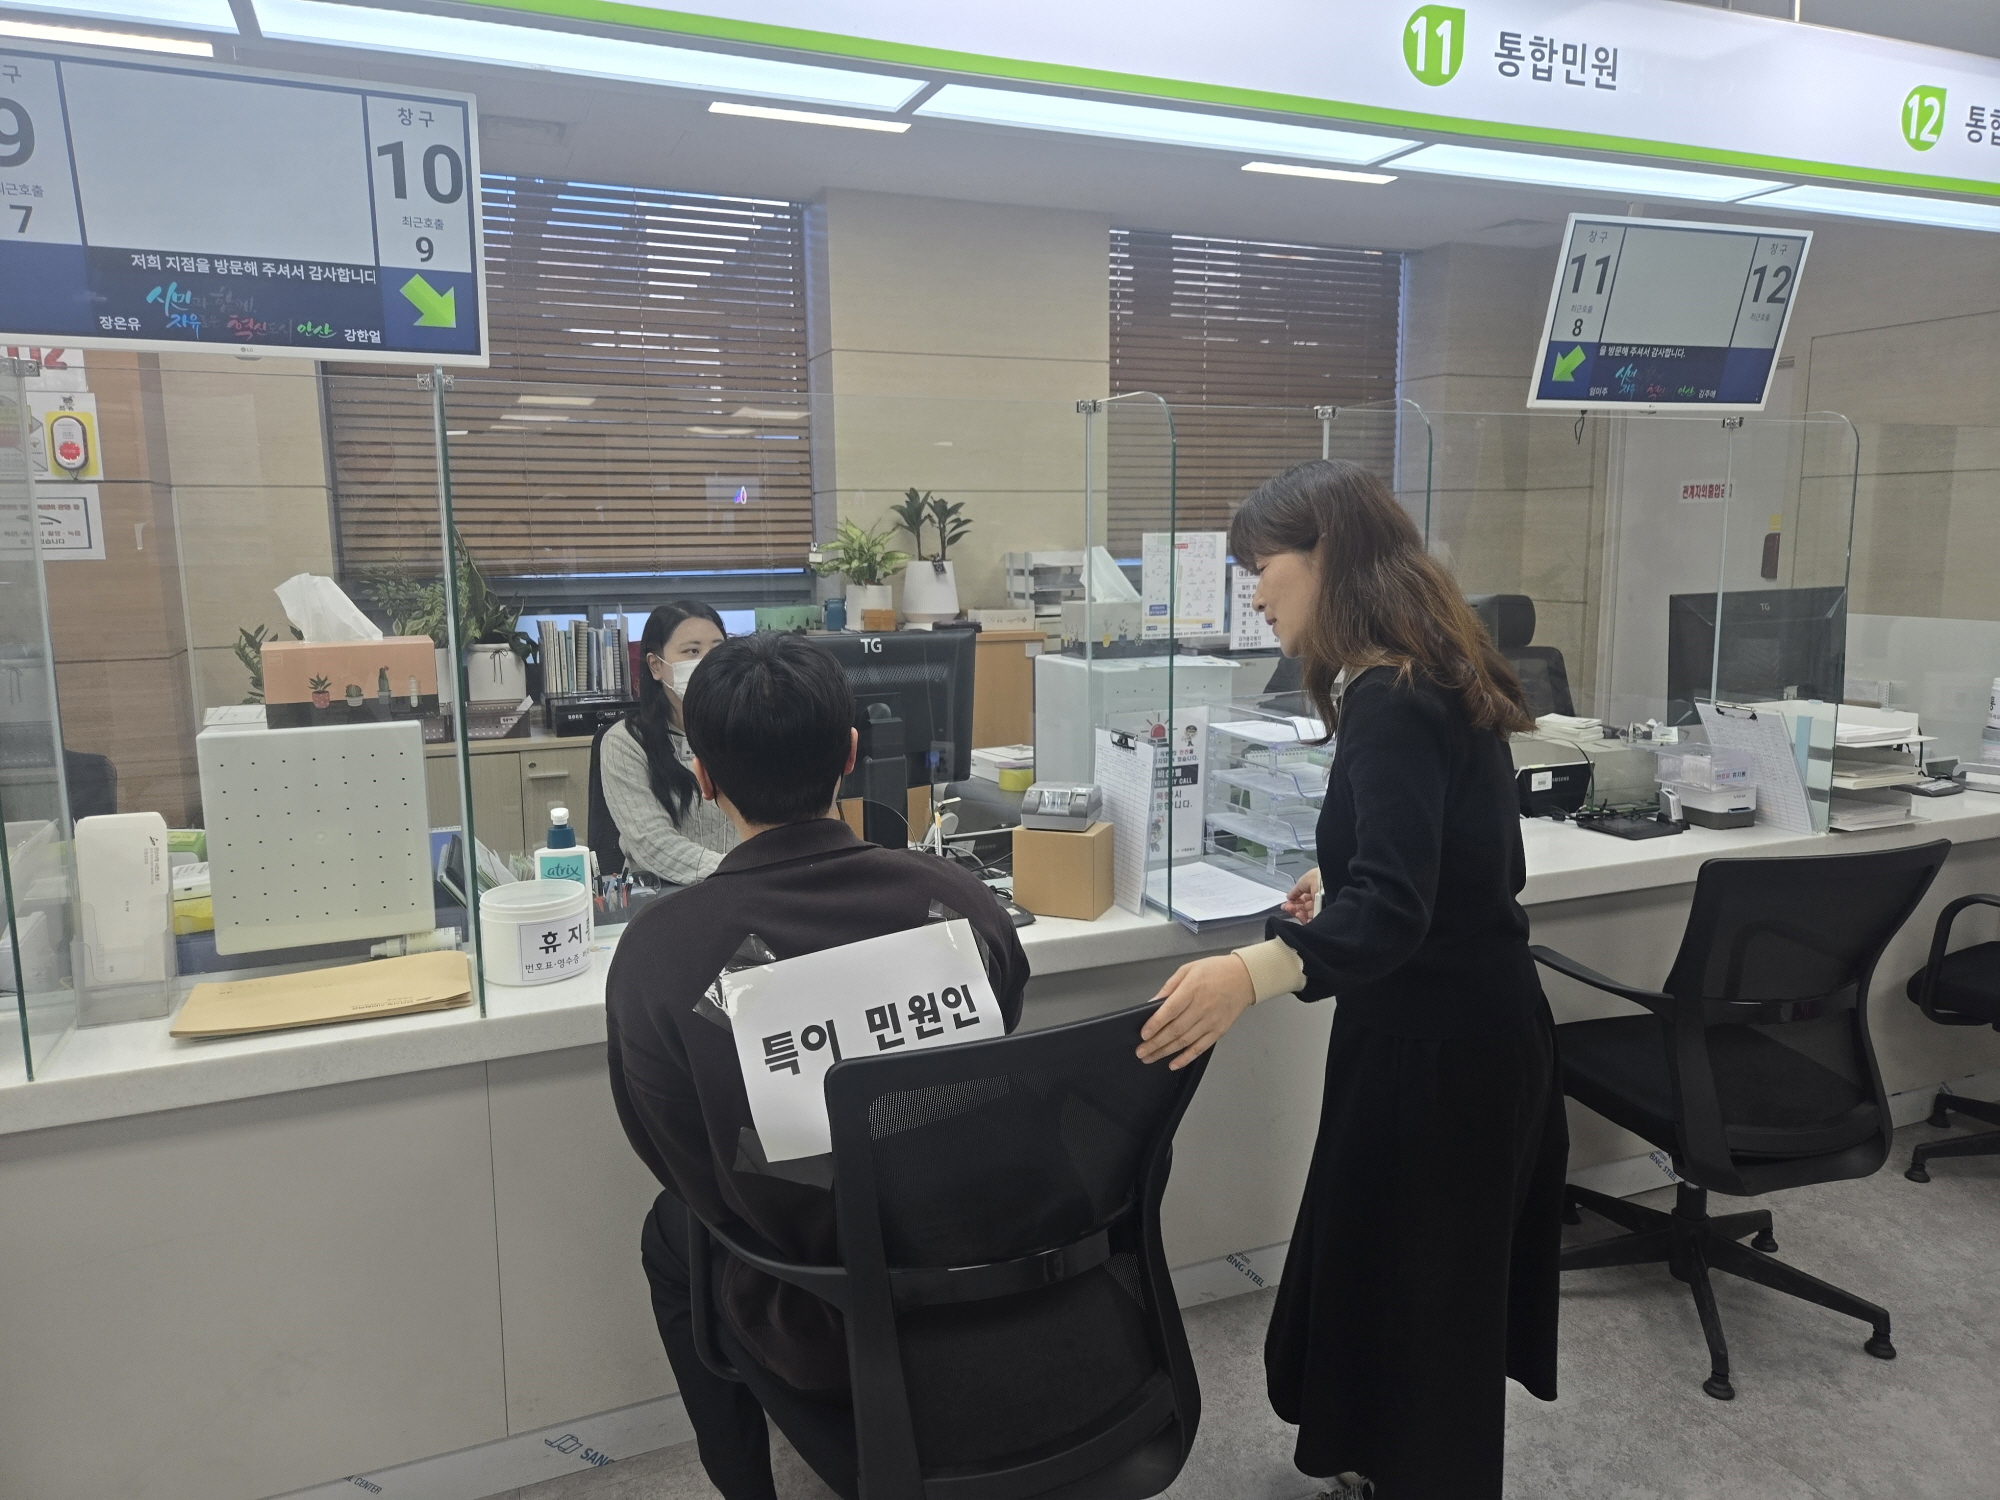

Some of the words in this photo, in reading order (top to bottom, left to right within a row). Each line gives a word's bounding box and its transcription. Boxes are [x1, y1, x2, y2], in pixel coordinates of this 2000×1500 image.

[1410, 16, 1453, 75] 11
[2, 64, 22, 83] 구
[1494, 31, 1620, 91] 통합민원
[1907, 94, 1942, 142] 12
[0, 97, 35, 167] 9
[377, 140, 463, 204] 10
[0, 182, 44, 198] 근호출
[9, 204, 33, 233] 7
[402, 216, 445, 231] 최근호출
[415, 236, 434, 262] 9
[131, 253, 161, 271] 저희
[165, 256, 211, 274] 지점을
[214, 259, 258, 277] 방문해
[262, 264, 305, 280] 주셔서
[1570, 253, 1611, 295] 11
[1752, 264, 1792, 304] 12
[99, 315, 141, 332] 장온유
[1572, 318, 1584, 337] 8
[1760, 603, 1770, 611] TG
[861, 638, 882, 653] TG
[547, 863, 579, 876] atrix
[762, 1019, 842, 1076] 특이
[865, 984, 980, 1052] 민원인
[1649, 1152, 1664, 1169] BNG
[1226, 1254, 1246, 1272] BNG
[1244, 1269, 1264, 1288] STEEL
[580, 1447, 616, 1467] SAN
[354, 1477, 383, 1495] CENTER
